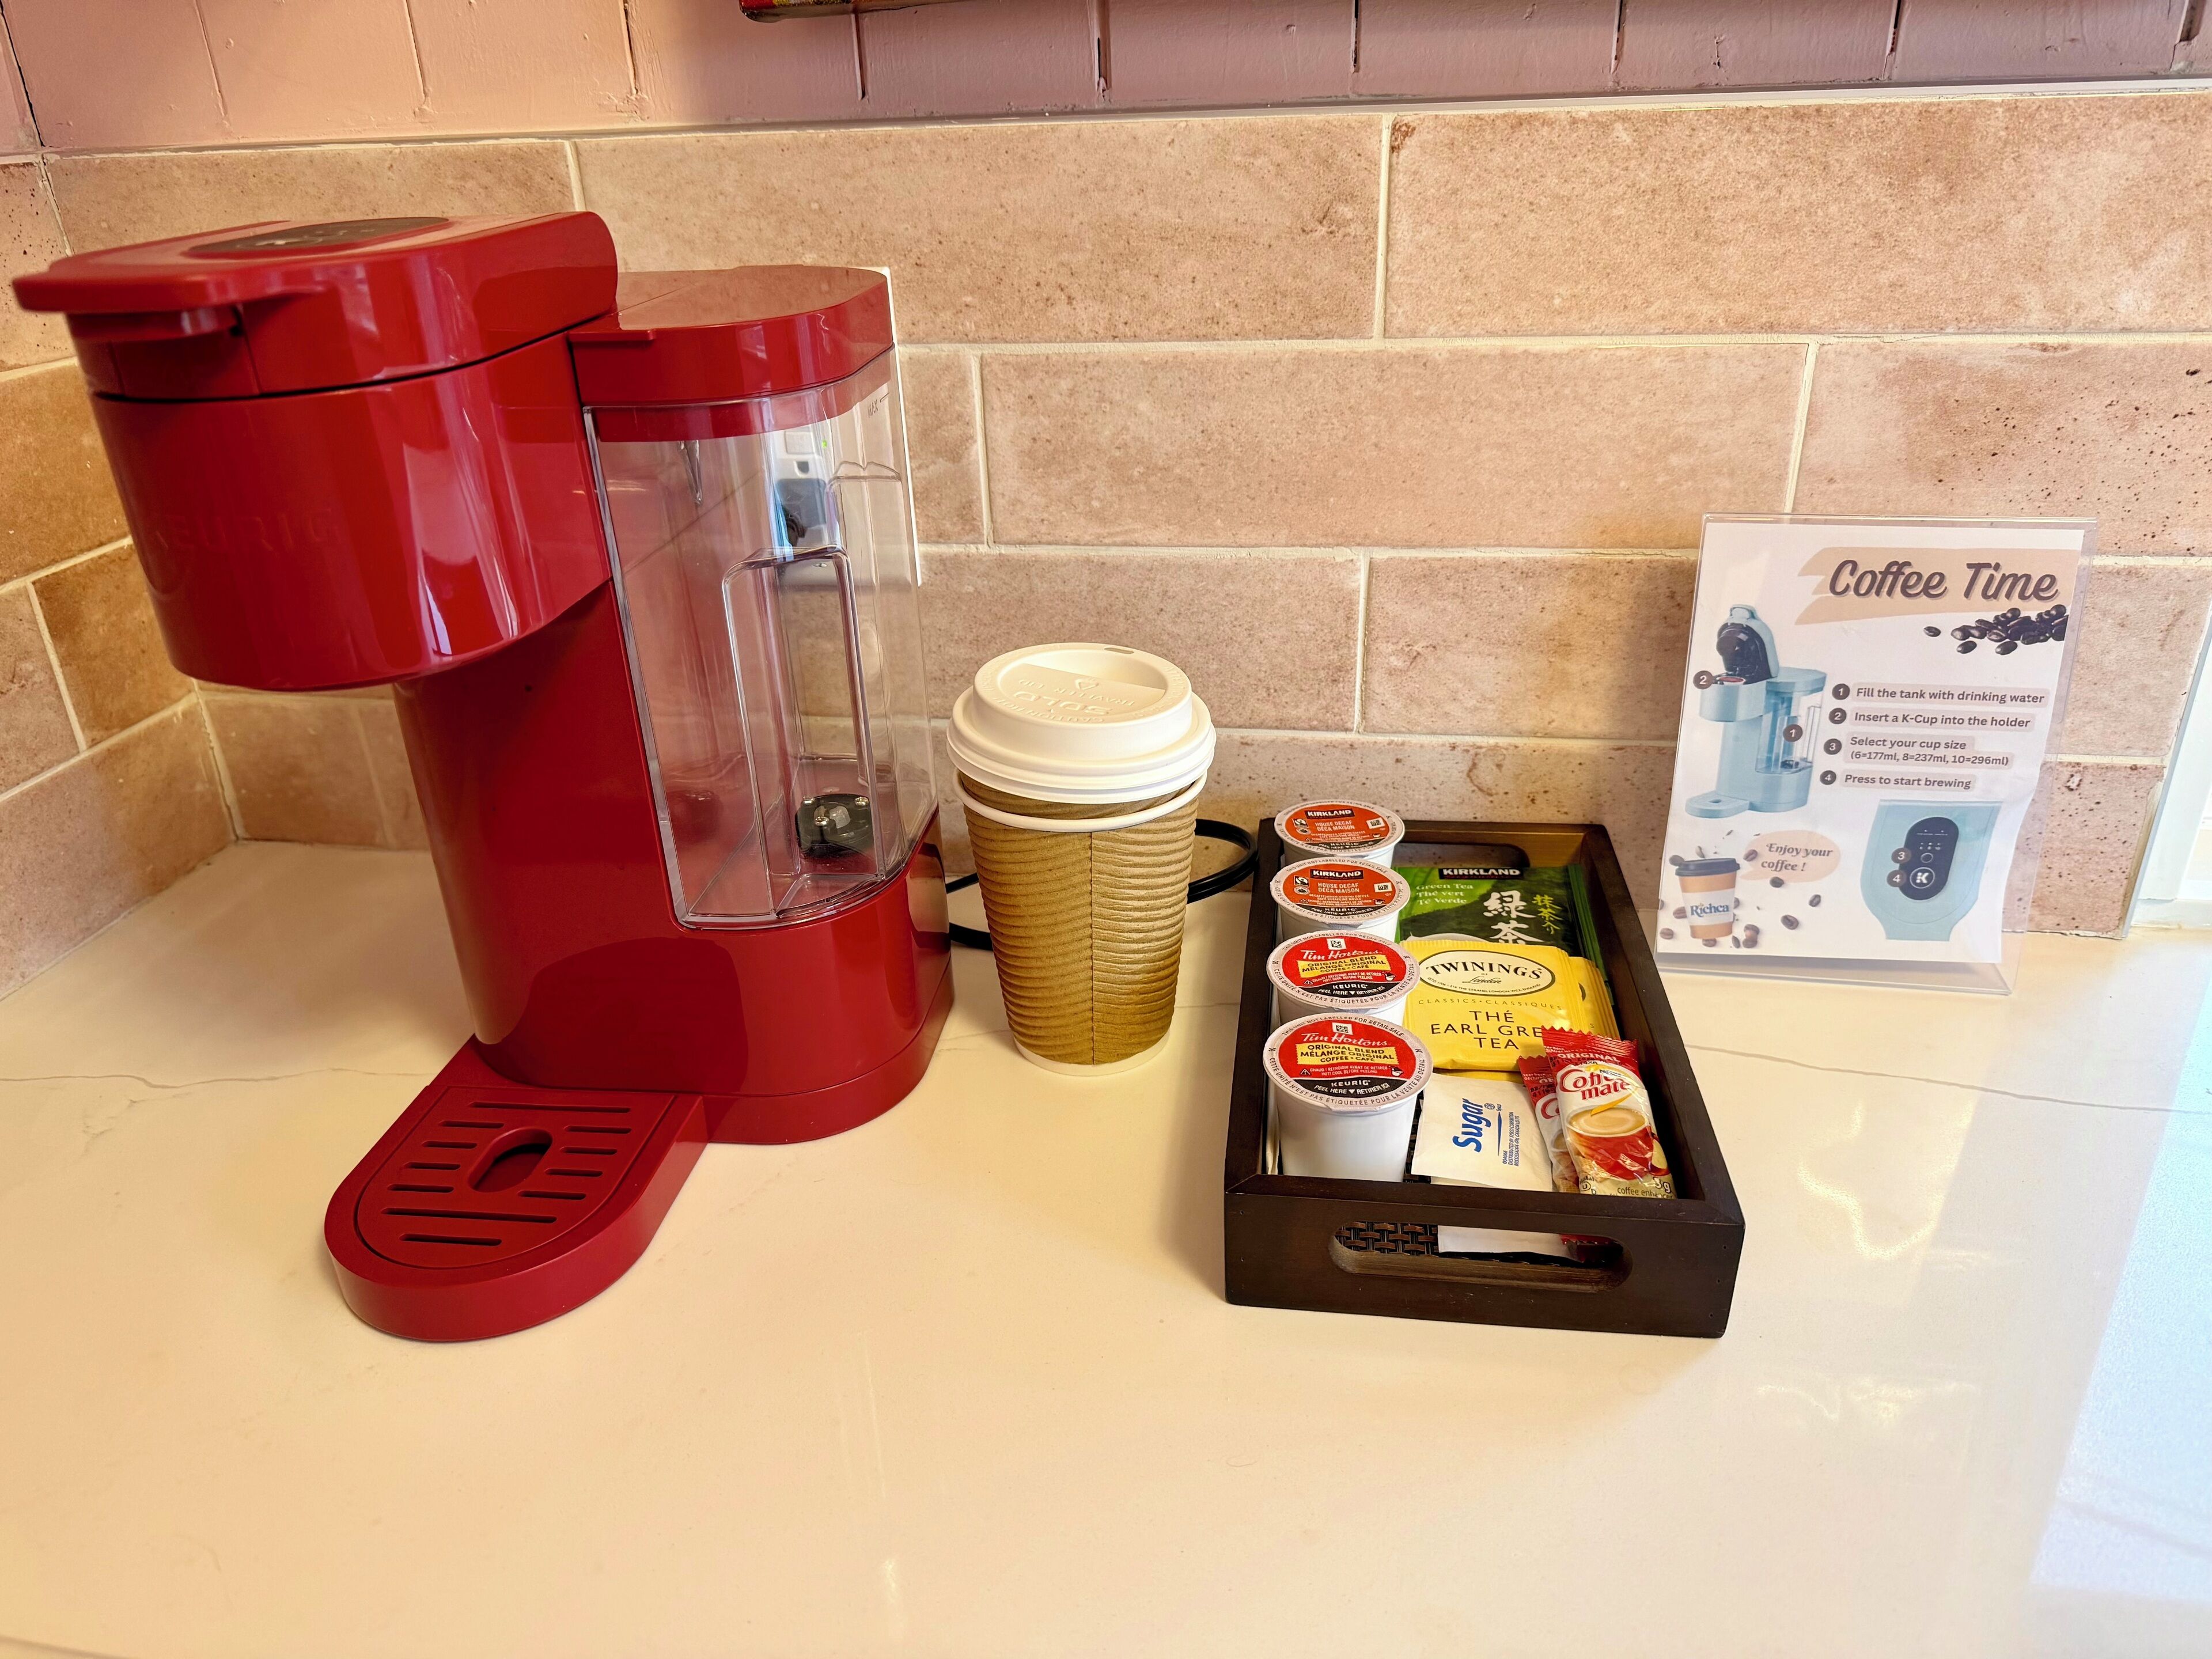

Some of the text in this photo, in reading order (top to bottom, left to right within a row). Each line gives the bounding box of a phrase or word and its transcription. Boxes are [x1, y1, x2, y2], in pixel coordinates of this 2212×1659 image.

[1829, 559, 2059, 601] Coffee Time
[1699, 676, 1707, 685] 2
[1838, 687, 2045, 704] 1 Fill the tank with drinking water
[1834, 712, 2031, 728] 2 Insert a K-Cup into the holder
[1790, 729, 1796, 737] 1
[1828, 736, 1967, 751] 3 Select your cup size
[1851, 751, 2009, 767] (6=177ml, 8=237ml, 10=296ml)
[1824, 774, 1972, 790] 4 Press to start brewing
[1766, 843, 1834, 858] Enjoy your
[1897, 851, 1906, 861] 3
[1760, 859, 1798, 872] coffee
[1892, 874, 1901, 883] 4
[1300, 949, 1380, 960] Tim Hortons
[1308, 959, 1349, 967] ORIGINAL
[1426, 961, 1542, 979] TWININGS
[1394, 980, 1410, 992] VENTE
[1462, 975, 1502, 984] London
[1485, 999, 1562, 1010] CLASSIQUES
[1469, 1010, 1514, 1023] THÉ
[1282, 1028, 1294, 1036] THIS
[1369, 1020, 1389, 1030] RETAIL
[1389, 1027, 1404, 1037] SALE
[1430, 1023, 1543, 1038] EARL GRE
[1301, 1032, 1388, 1046] Tim Hortons
[1473, 1036, 1520, 1050] TEA
[1300, 1049, 1395, 1059] MÉLANGE ORIGINAL
[1557, 1052, 1620, 1063] ORIGINAL
[1269, 1056, 1279, 1072] CETTE
[1417, 1059, 1426, 1075] DÉTAIL
[1275, 1071, 1291, 1085] UNITÉ
[1414, 1074, 1422, 1082] AU
[1289, 1084, 1309, 1096] N'EST
[1356, 1085, 1382, 1095] RETIRER
[1399, 1080, 1418, 1095] VENTE
[1581, 1080, 1630, 1101] mate
[1309, 1093, 1324, 1101] PAS
[1325, 1096, 1369, 1105] ÉTIQUETÉE
[1370, 1095, 1392, 1104] POUR
[1452, 1097, 1491, 1153] Sugar
[1617, 1187, 1639, 1195] coffee
